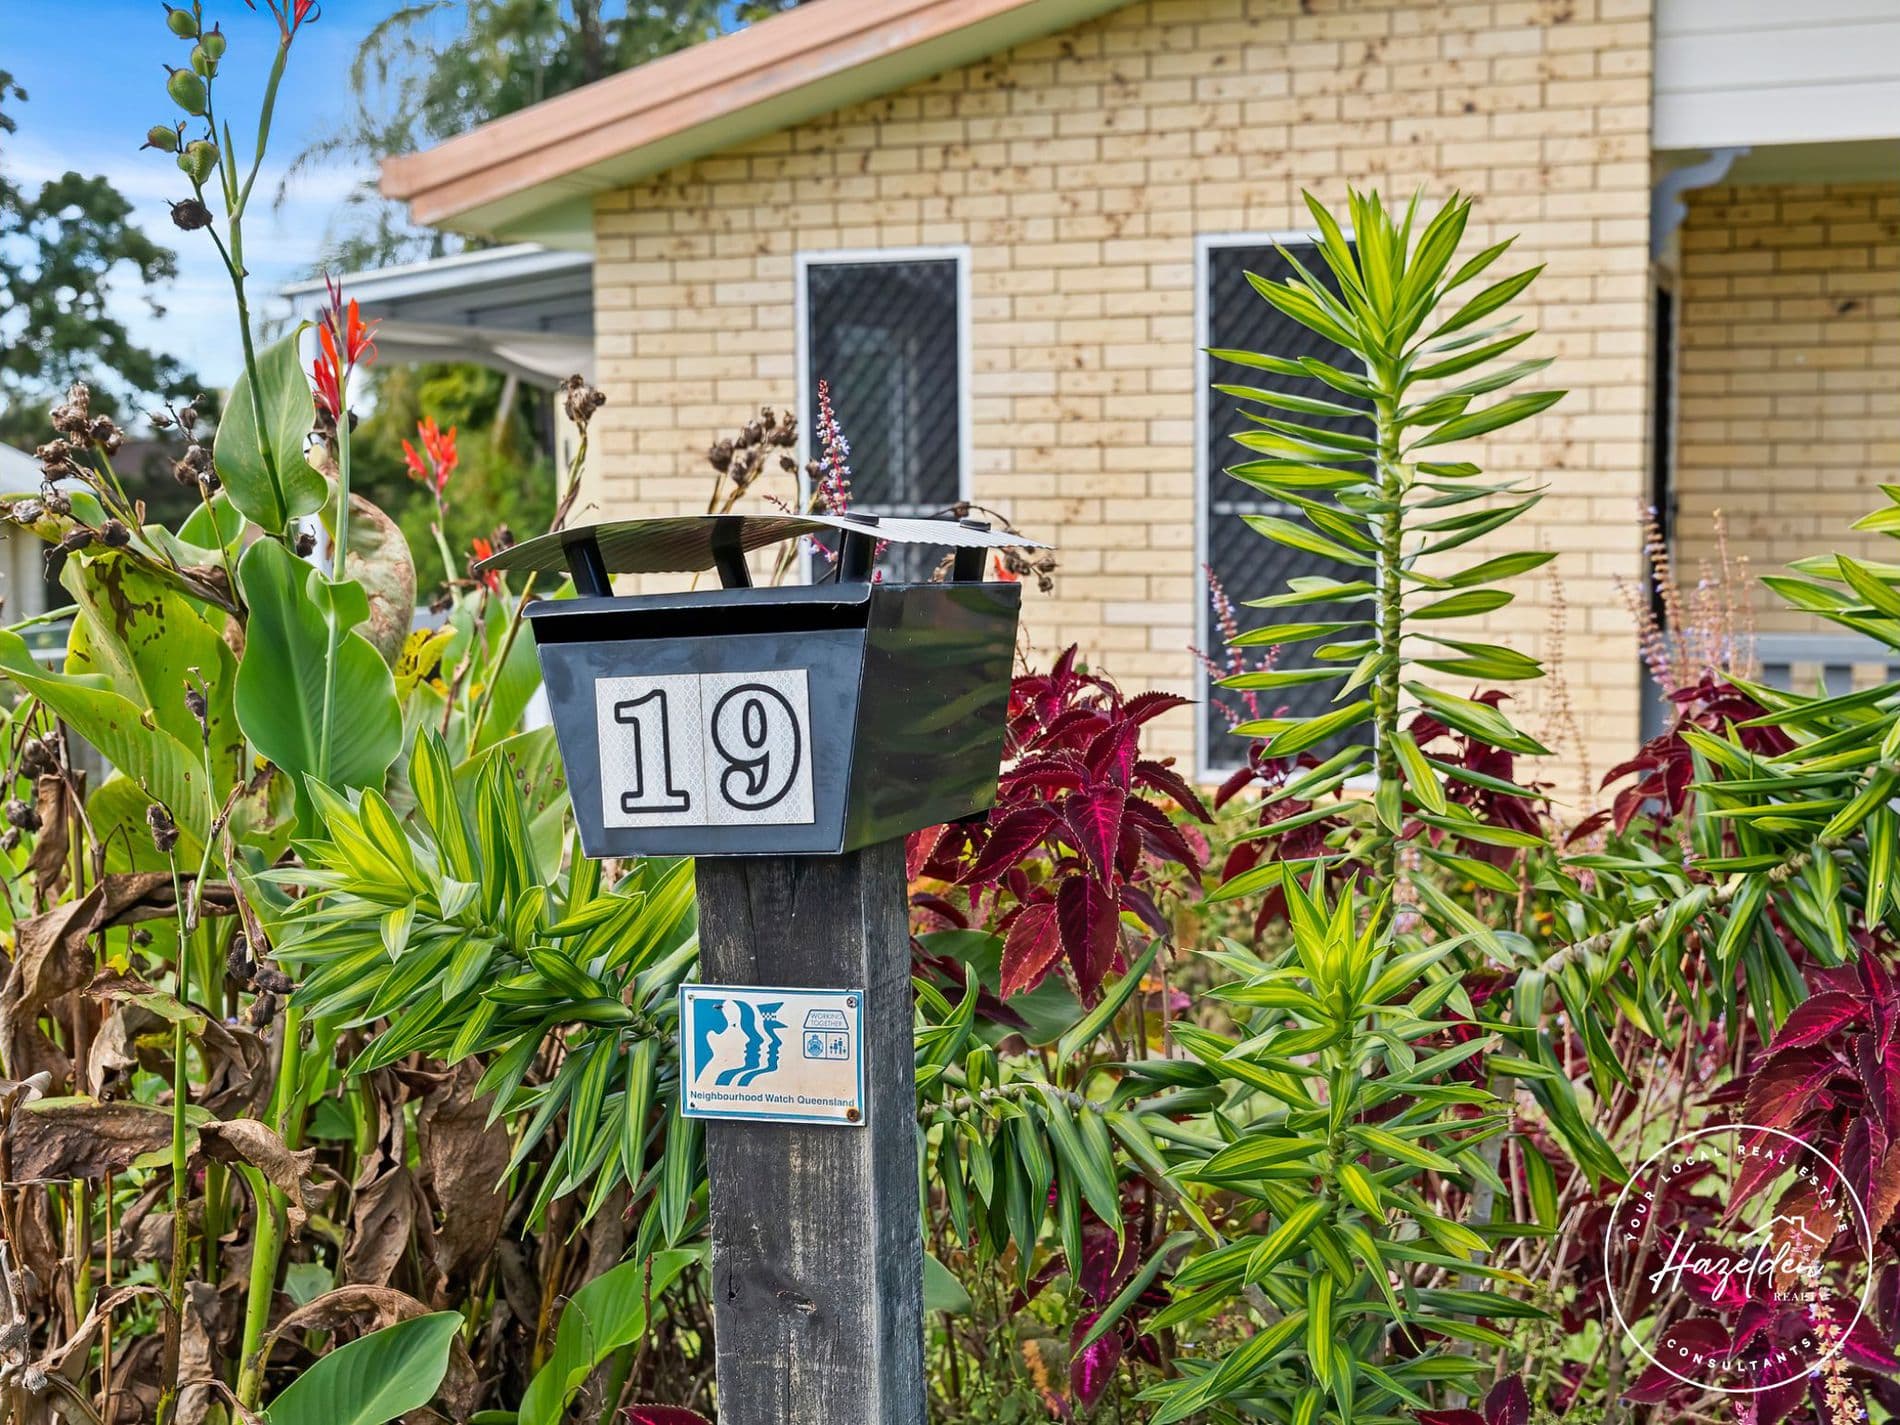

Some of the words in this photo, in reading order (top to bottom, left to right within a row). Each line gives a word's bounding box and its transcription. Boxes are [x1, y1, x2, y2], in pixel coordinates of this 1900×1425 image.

[614, 683, 801, 814] 19
[811, 1019, 843, 1027] TOGETHER
[690, 1091, 763, 1103] Neighbourhood
[765, 1094, 794, 1104] Watch
[797, 1095, 855, 1107] Queensland
